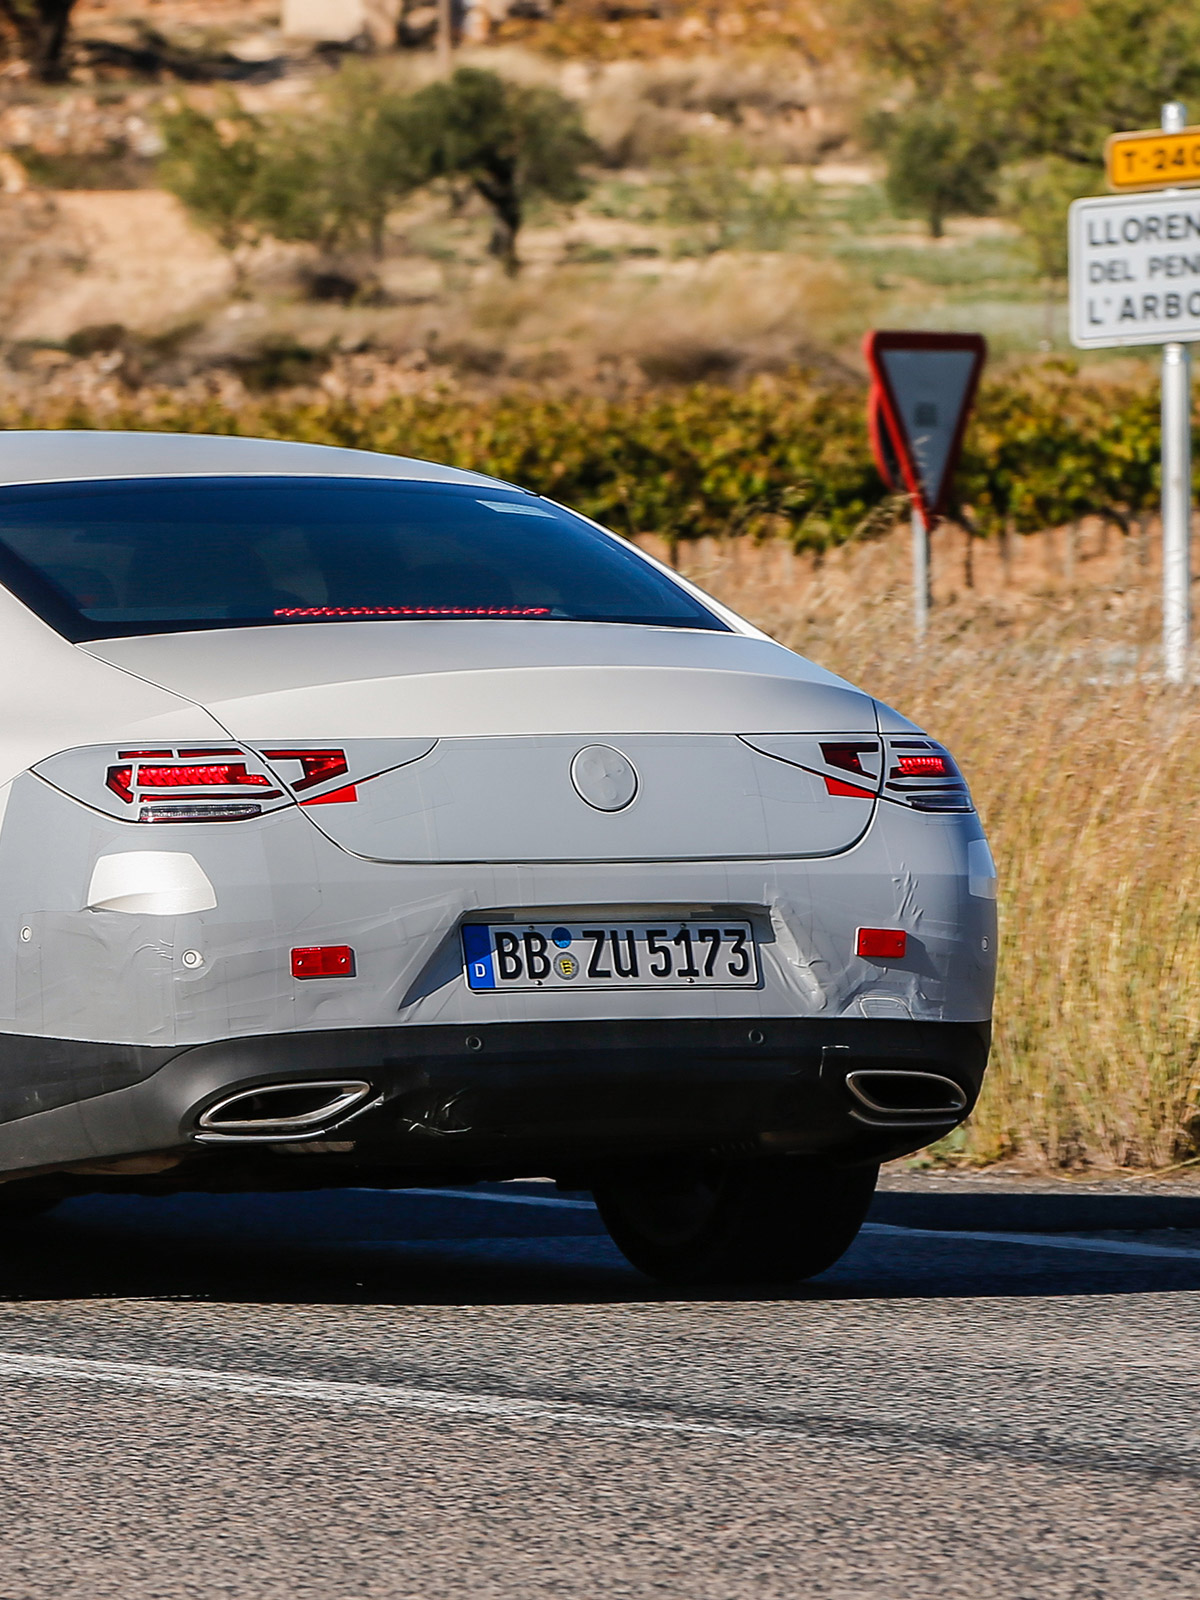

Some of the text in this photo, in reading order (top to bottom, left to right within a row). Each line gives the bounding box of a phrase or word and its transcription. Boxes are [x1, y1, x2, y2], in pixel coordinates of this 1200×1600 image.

[1089, 259, 1135, 282] DEL
[495, 931, 549, 979] BB
[646, 929, 750, 977] 5173
[475, 963, 486, 977] D
